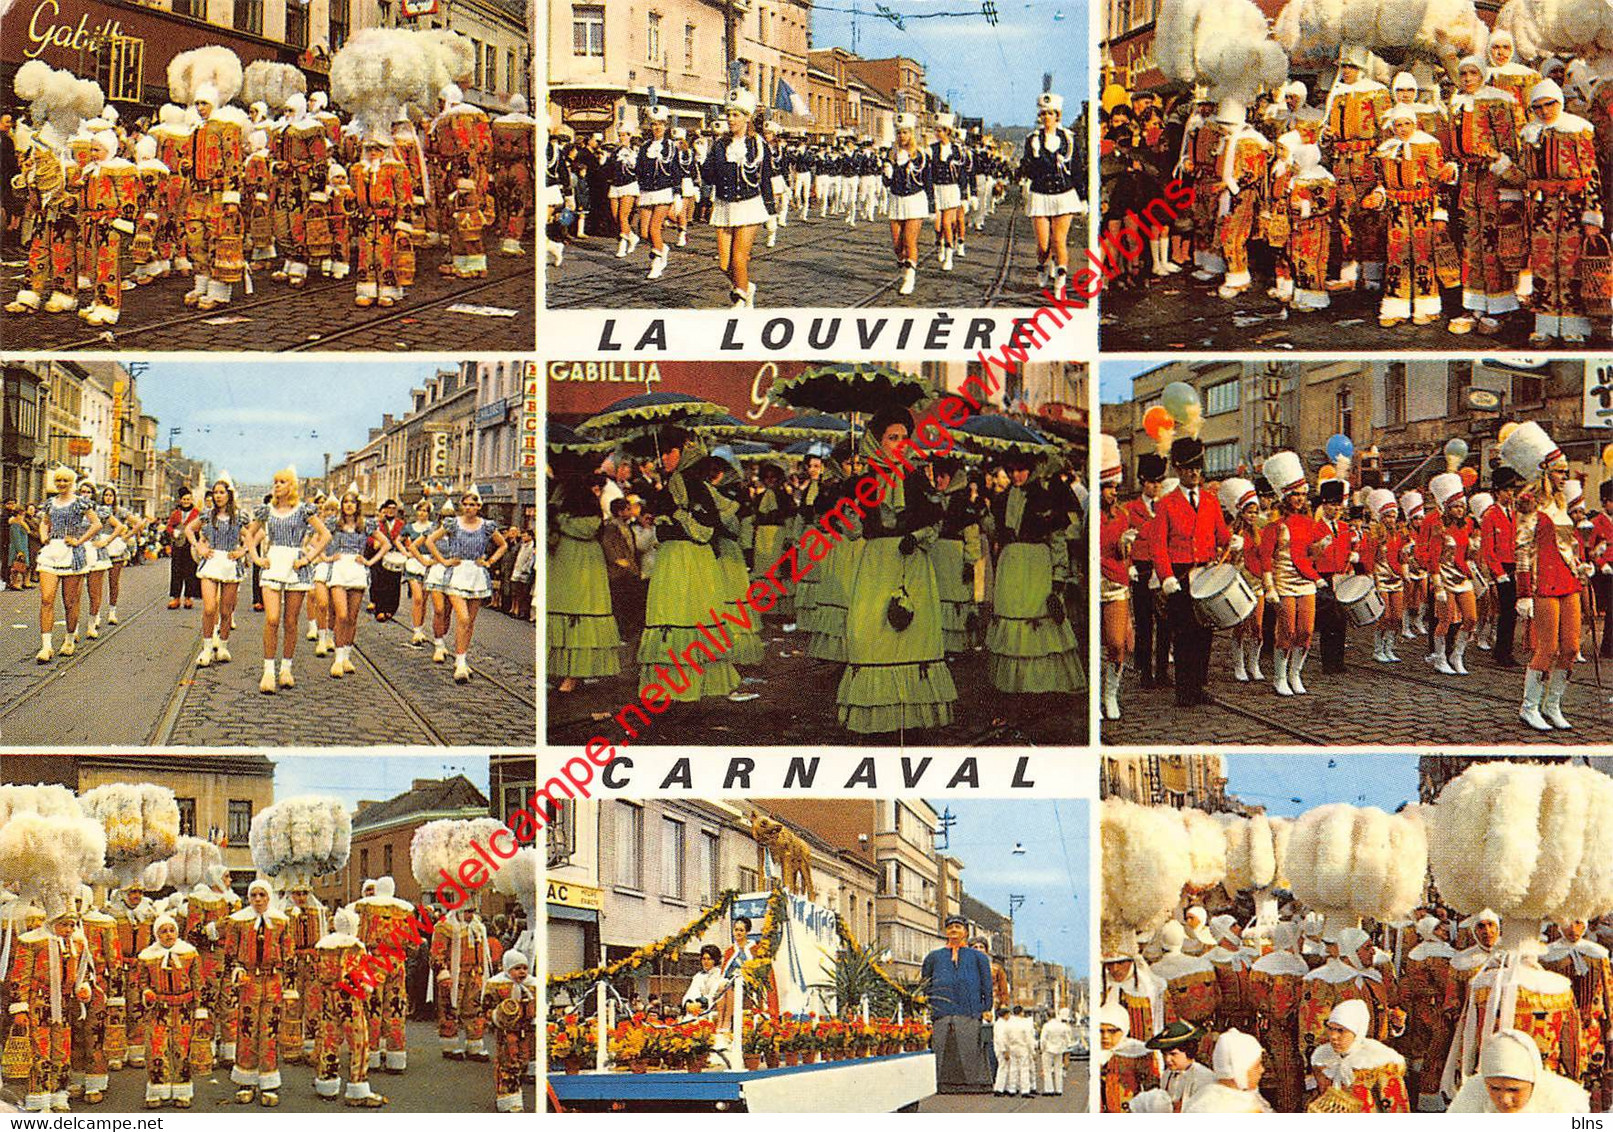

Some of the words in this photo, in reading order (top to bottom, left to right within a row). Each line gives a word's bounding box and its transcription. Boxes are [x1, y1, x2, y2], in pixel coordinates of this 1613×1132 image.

[598, 318, 667, 350] LA
[721, 312, 1038, 350] LOUVIÈRE
[549, 362, 662, 382] GABILLIA
[602, 756, 1035, 789] CARNAVAL
